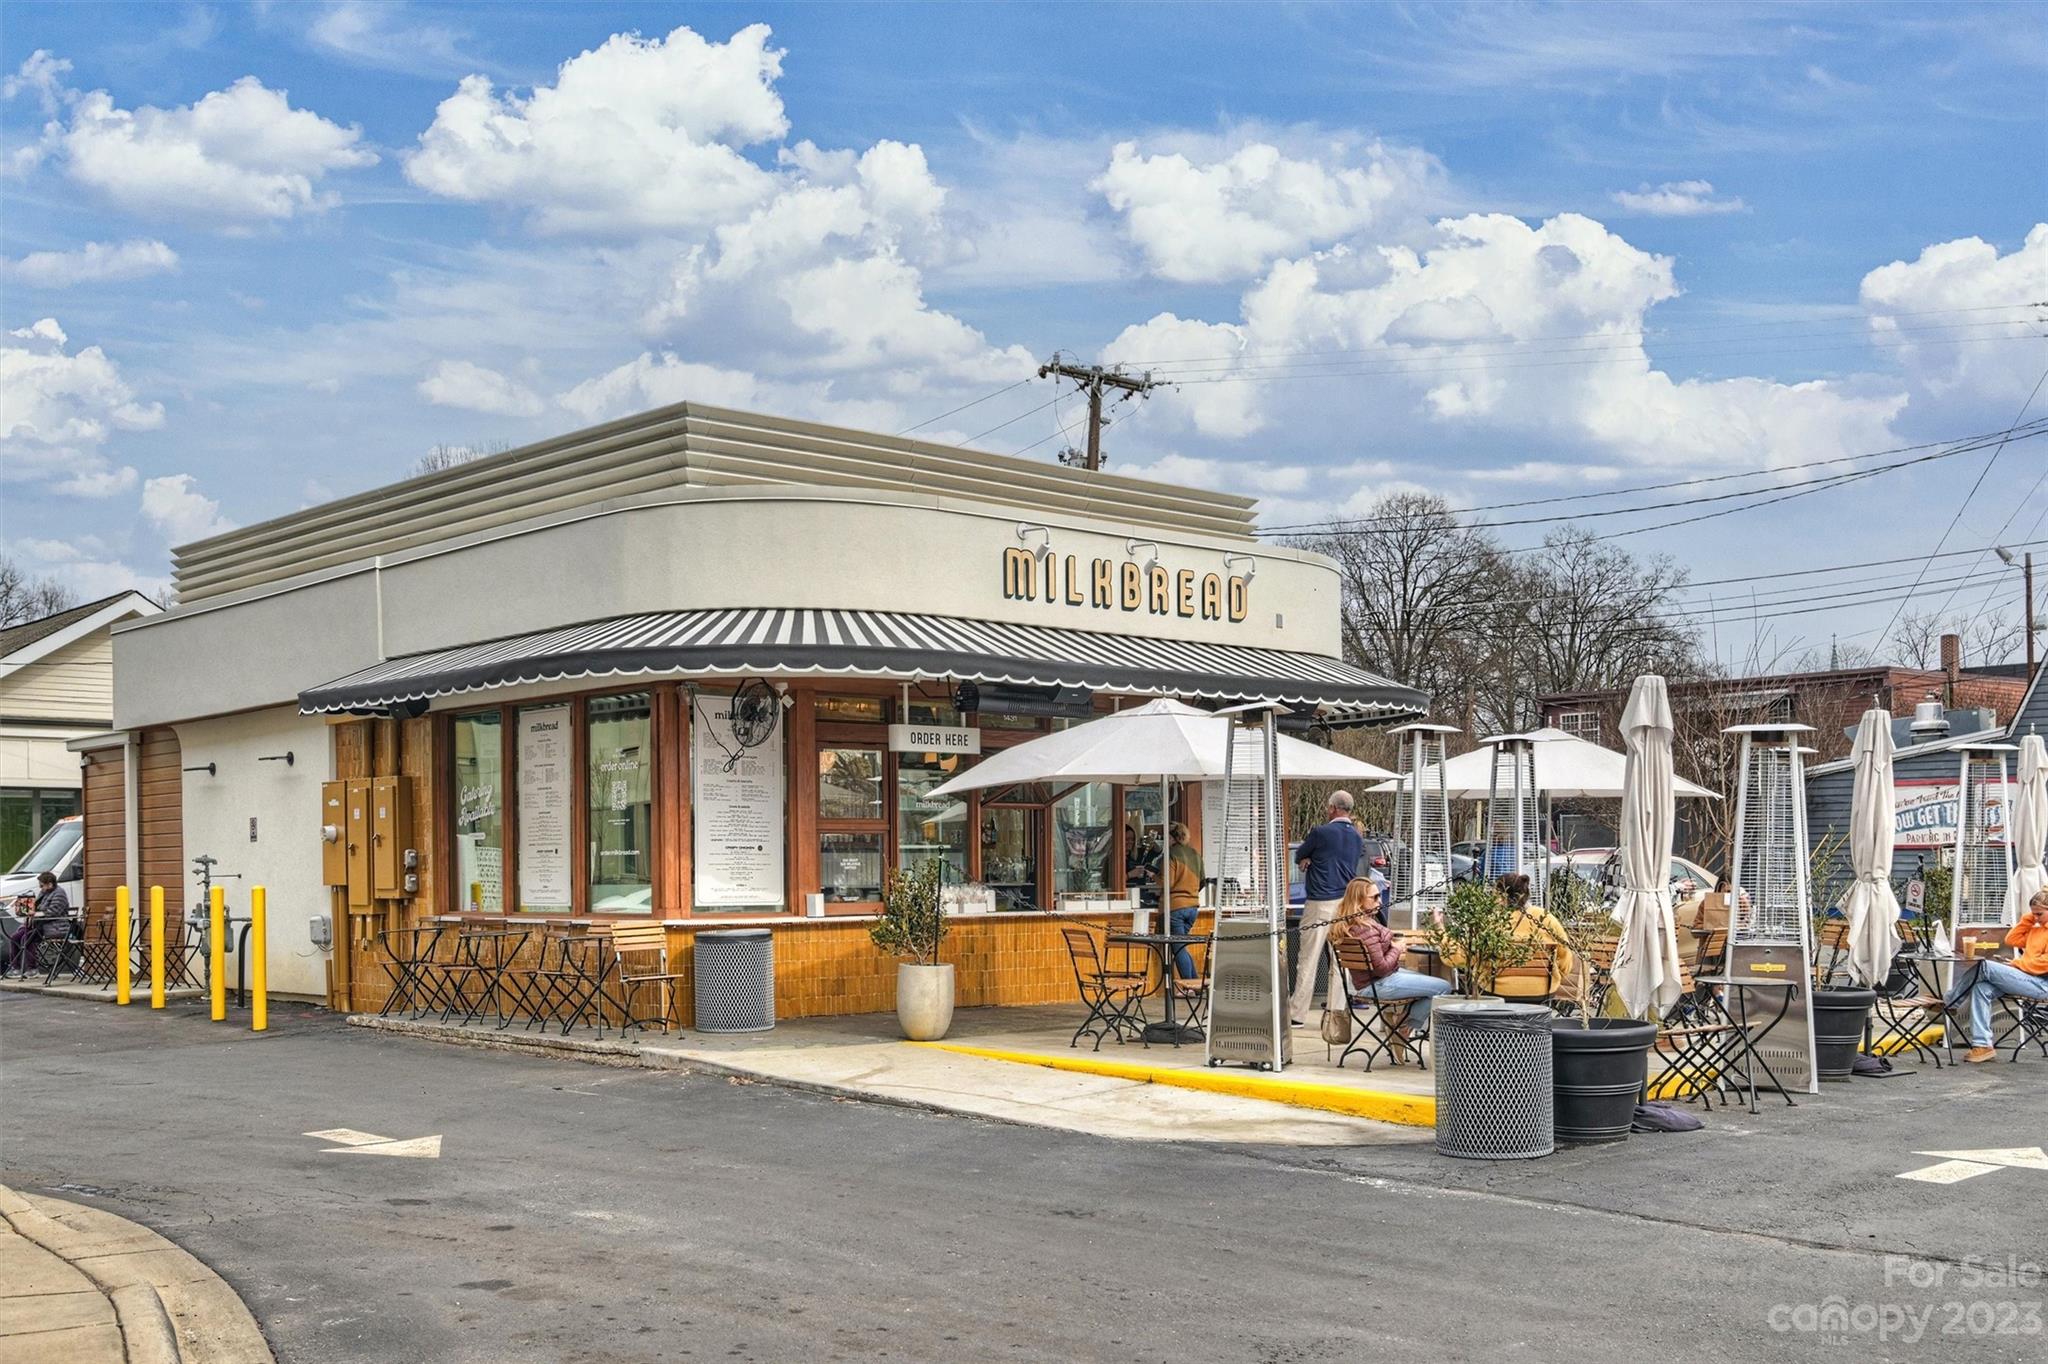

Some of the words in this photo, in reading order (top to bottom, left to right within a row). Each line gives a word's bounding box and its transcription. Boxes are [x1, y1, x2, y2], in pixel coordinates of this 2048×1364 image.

[1003, 547, 1248, 623] MILKBREAD
[530, 720, 559, 733] milkbread
[910, 732, 941, 746] ORDER
[945, 734, 969, 746] HERE
[600, 760, 617, 772] order
[618, 759, 639, 770] online
[460, 785, 492, 805] Catering
[916, 801, 950, 809] milkbread
[458, 802, 495, 826] Available
[1895, 811, 1915, 832] OW
[1917, 804, 1940, 826] GET
